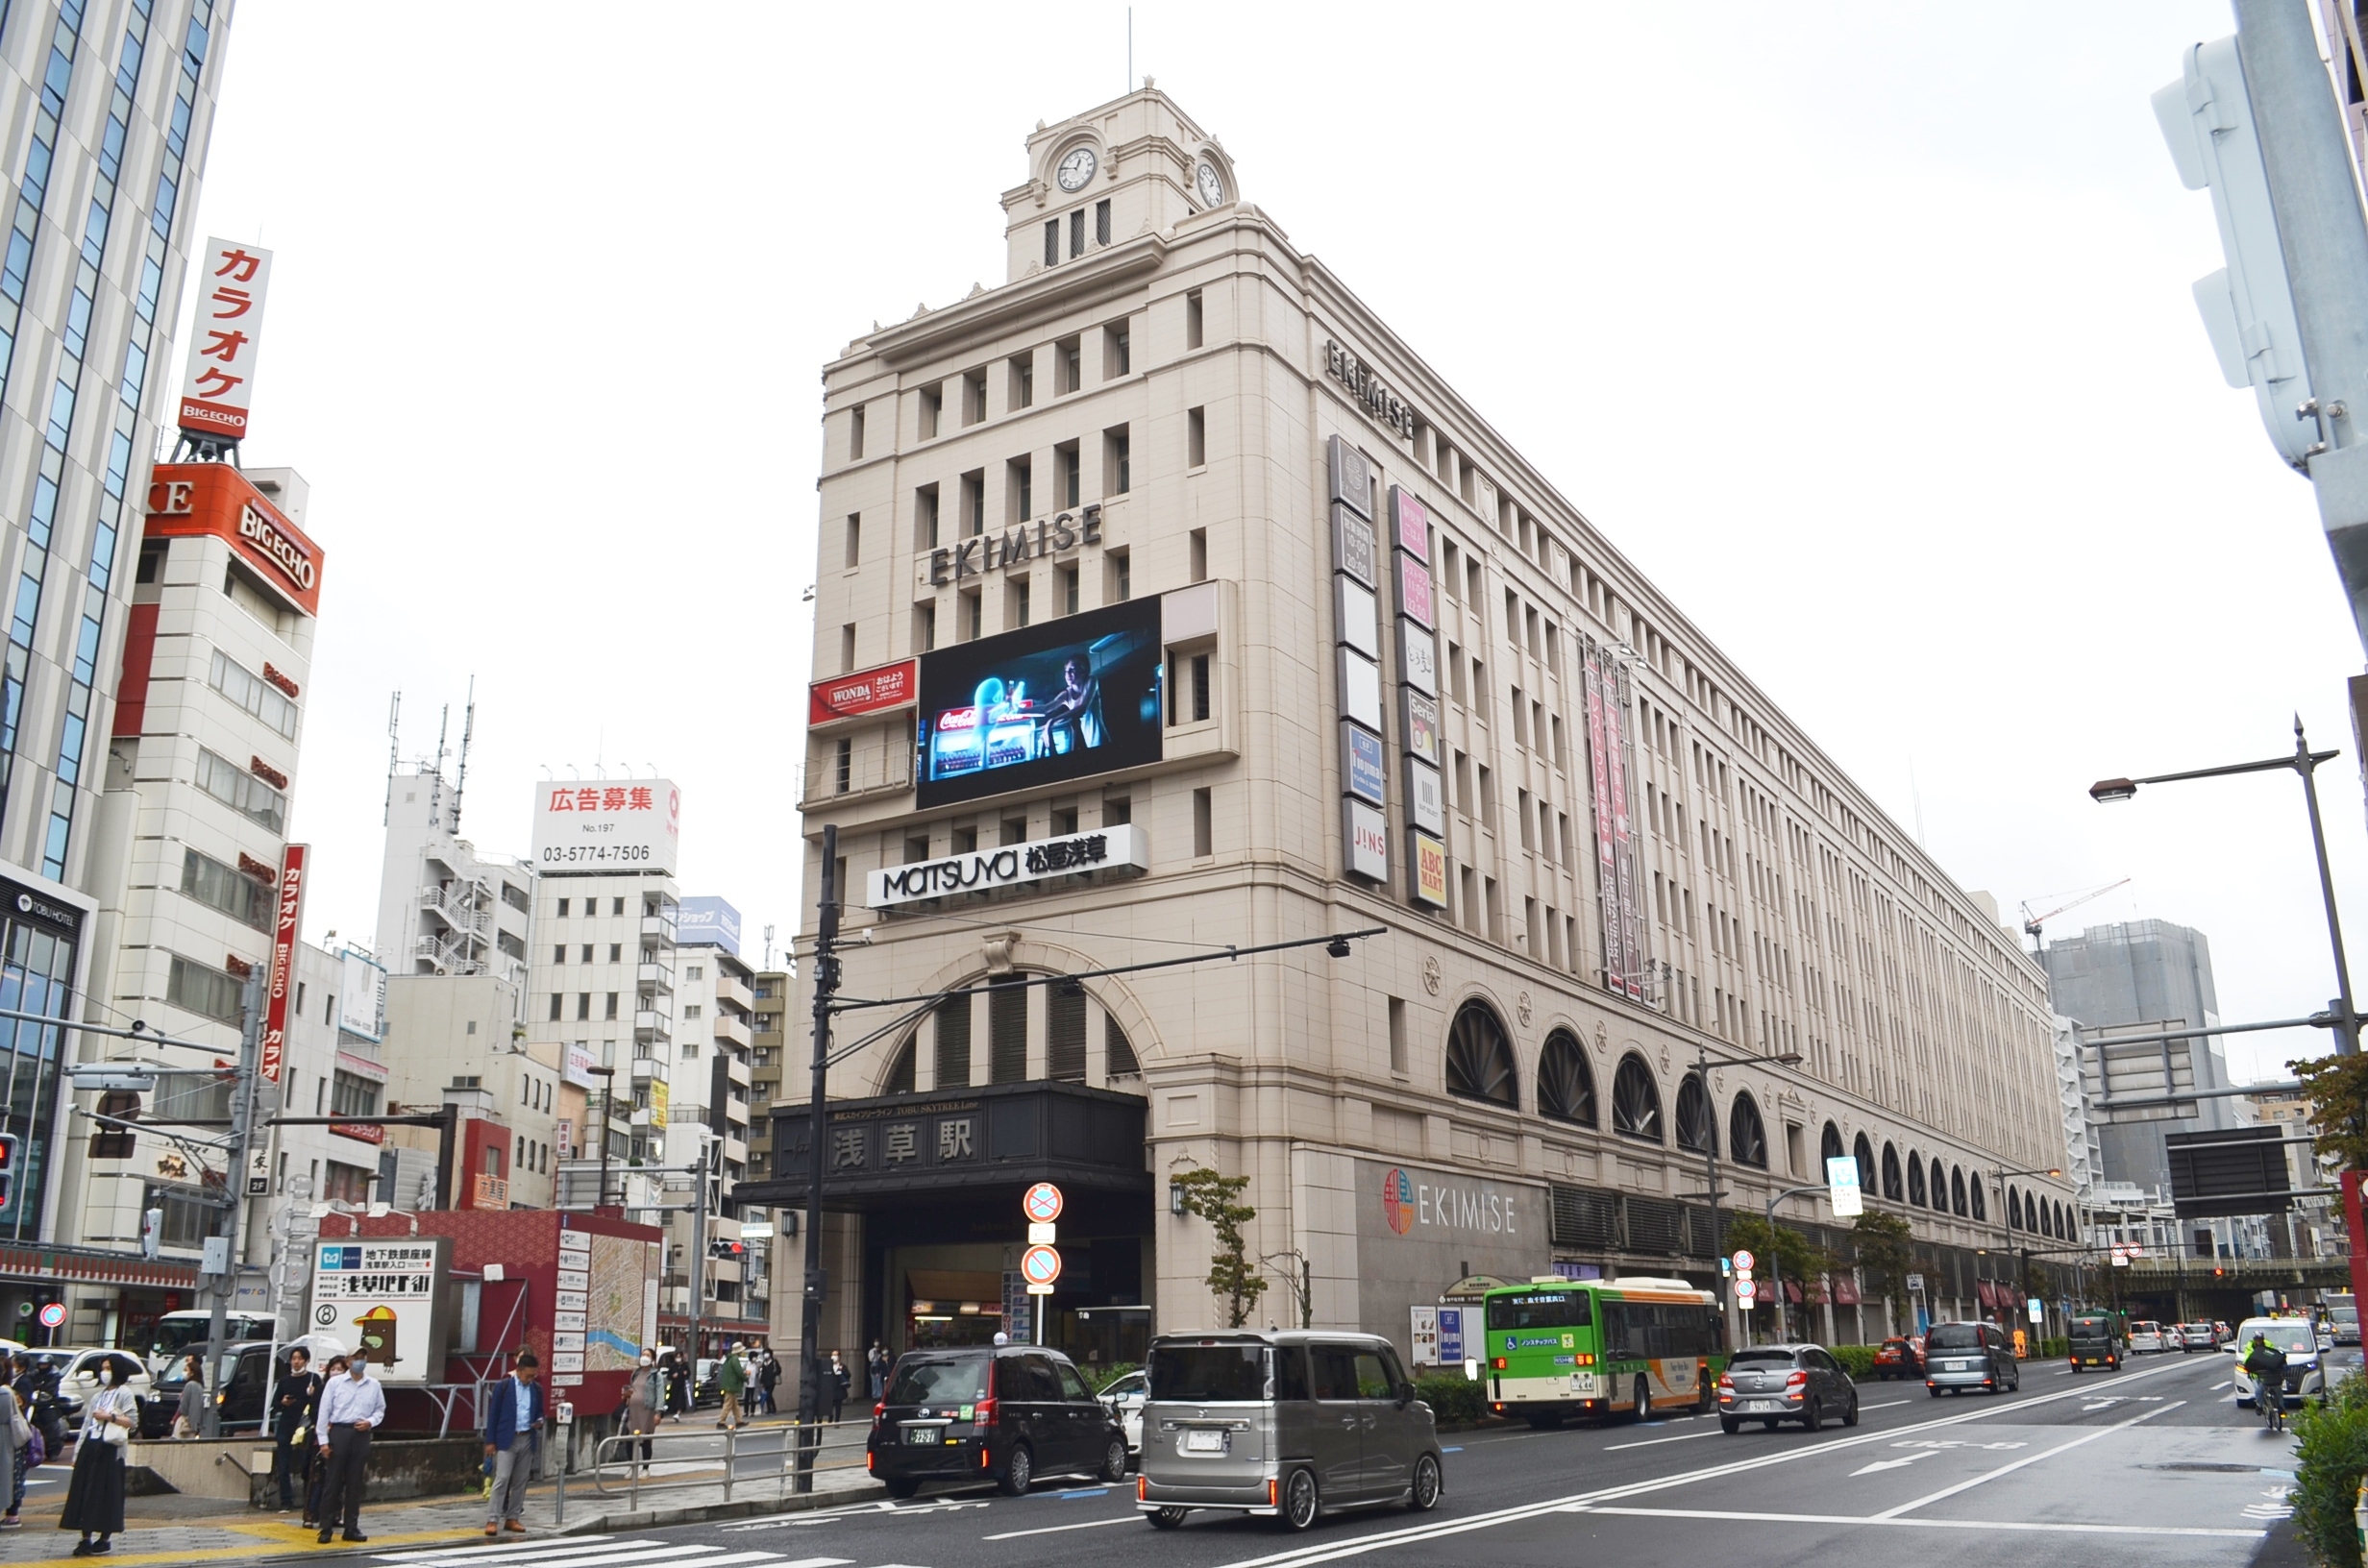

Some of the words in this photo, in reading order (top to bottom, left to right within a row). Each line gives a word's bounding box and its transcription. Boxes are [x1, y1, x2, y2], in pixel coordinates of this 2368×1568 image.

[195, 249, 260, 398] カラオケ
[1326, 339, 1414, 441] EKIMISE
[183, 404, 209, 420] BIG
[210, 410, 246, 427] ECHO
[1342, 481, 1369, 509] EKIMISE
[241, 504, 273, 550] BIG
[273, 537, 315, 590] ECHO
[930, 503, 1102, 587] EKIMISE
[1347, 532, 1368, 556] 10:00
[1404, 522, 1423, 548] ごはん
[1346, 552, 1368, 577] 20:00
[1405, 561, 1427, 586] レストラン
[1408, 577, 1425, 600] 11:00
[1407, 598, 1427, 620] 22:00
[876, 672, 903, 685] おはよう
[832, 684, 871, 703] WONDA
[1411, 698, 1435, 724] Seria
[549, 786, 653, 812] 広告募集
[582, 824, 615, 833] No.197
[543, 845, 651, 862] 03-5774-7506
[1025, 834, 1107, 874] 松屋浅草
[1421, 848, 1443, 875] ABC
[1421, 870, 1443, 894] MART
[279, 868, 301, 931] カラオケ
[32, 901, 52, 919] TOBU
[52, 908, 74, 927] HOTEL
[277, 943, 289, 966] BIG
[272, 967, 285, 998] ECHO
[262, 1029, 283, 1081] カラオ
[834, 1108, 893, 1121] 東武スカイツリーライン
[897, 1106, 920, 1115] TOBU
[921, 1102, 960, 1114] SKYTREE
[961, 1101, 978, 1110] Line
[833, 1119, 973, 1166] 浅草駅
[252, 1182, 264, 1190] 2F
[1419, 1185, 1516, 1234] EKIMISE
[366, 1249, 432, 1260] 地下鉄銀座線
[341, 1275, 431, 1293] 浅草地下街
